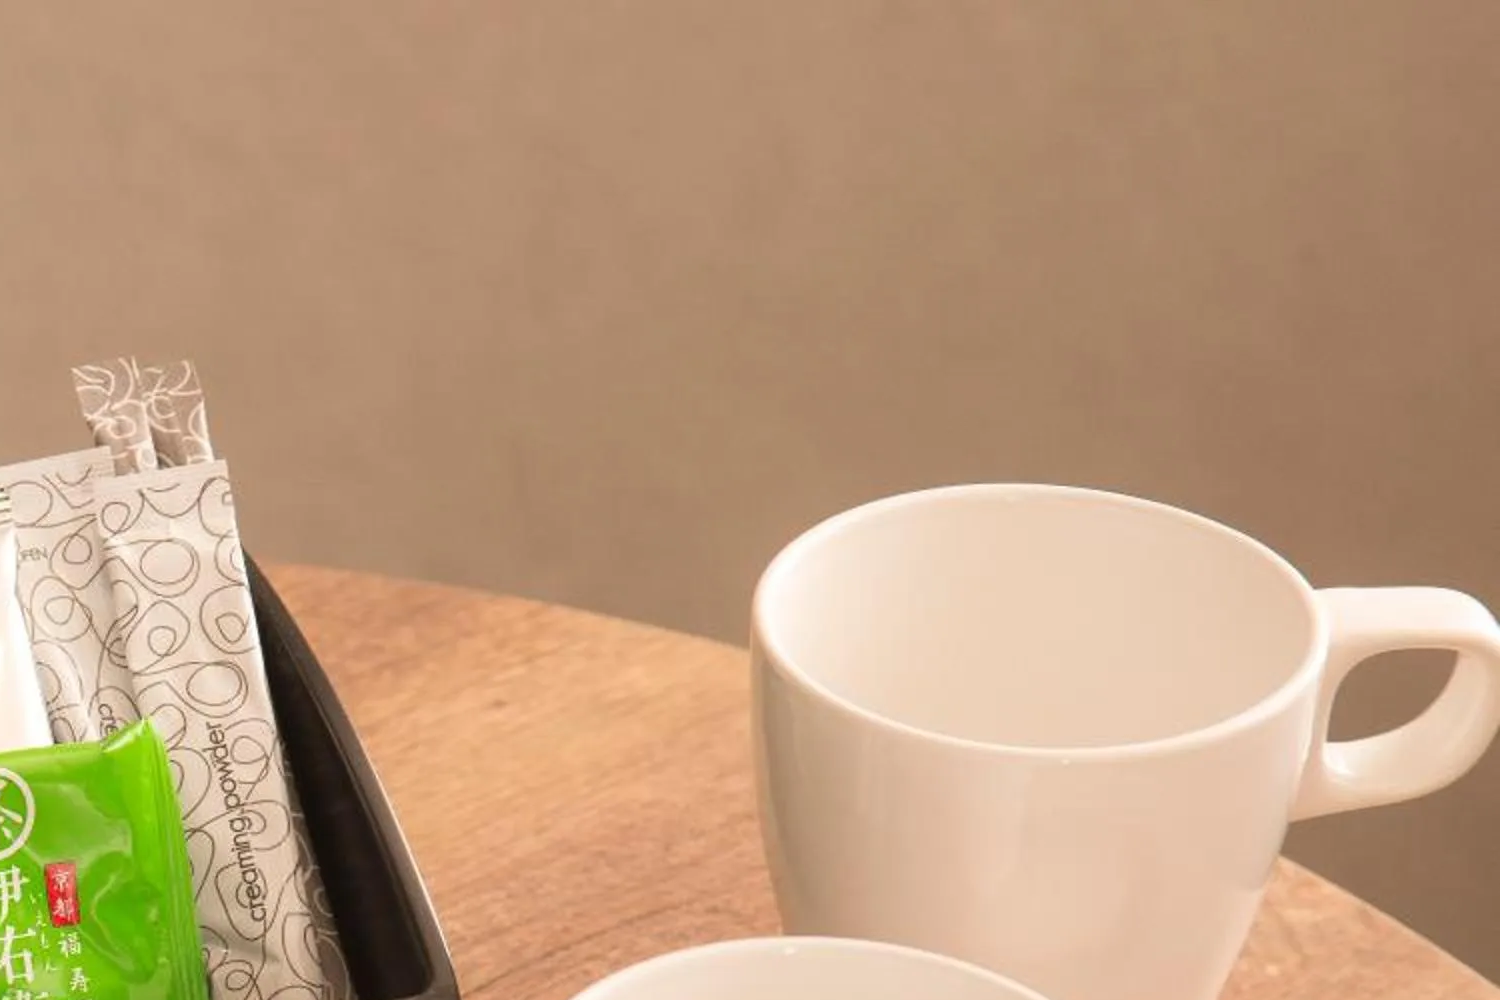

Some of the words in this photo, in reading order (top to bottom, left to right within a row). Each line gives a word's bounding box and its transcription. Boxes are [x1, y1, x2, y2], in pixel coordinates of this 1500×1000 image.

[204, 721, 243, 811] powder
[52, 871, 75, 921] 京都
[228, 815, 267, 922] creaming
